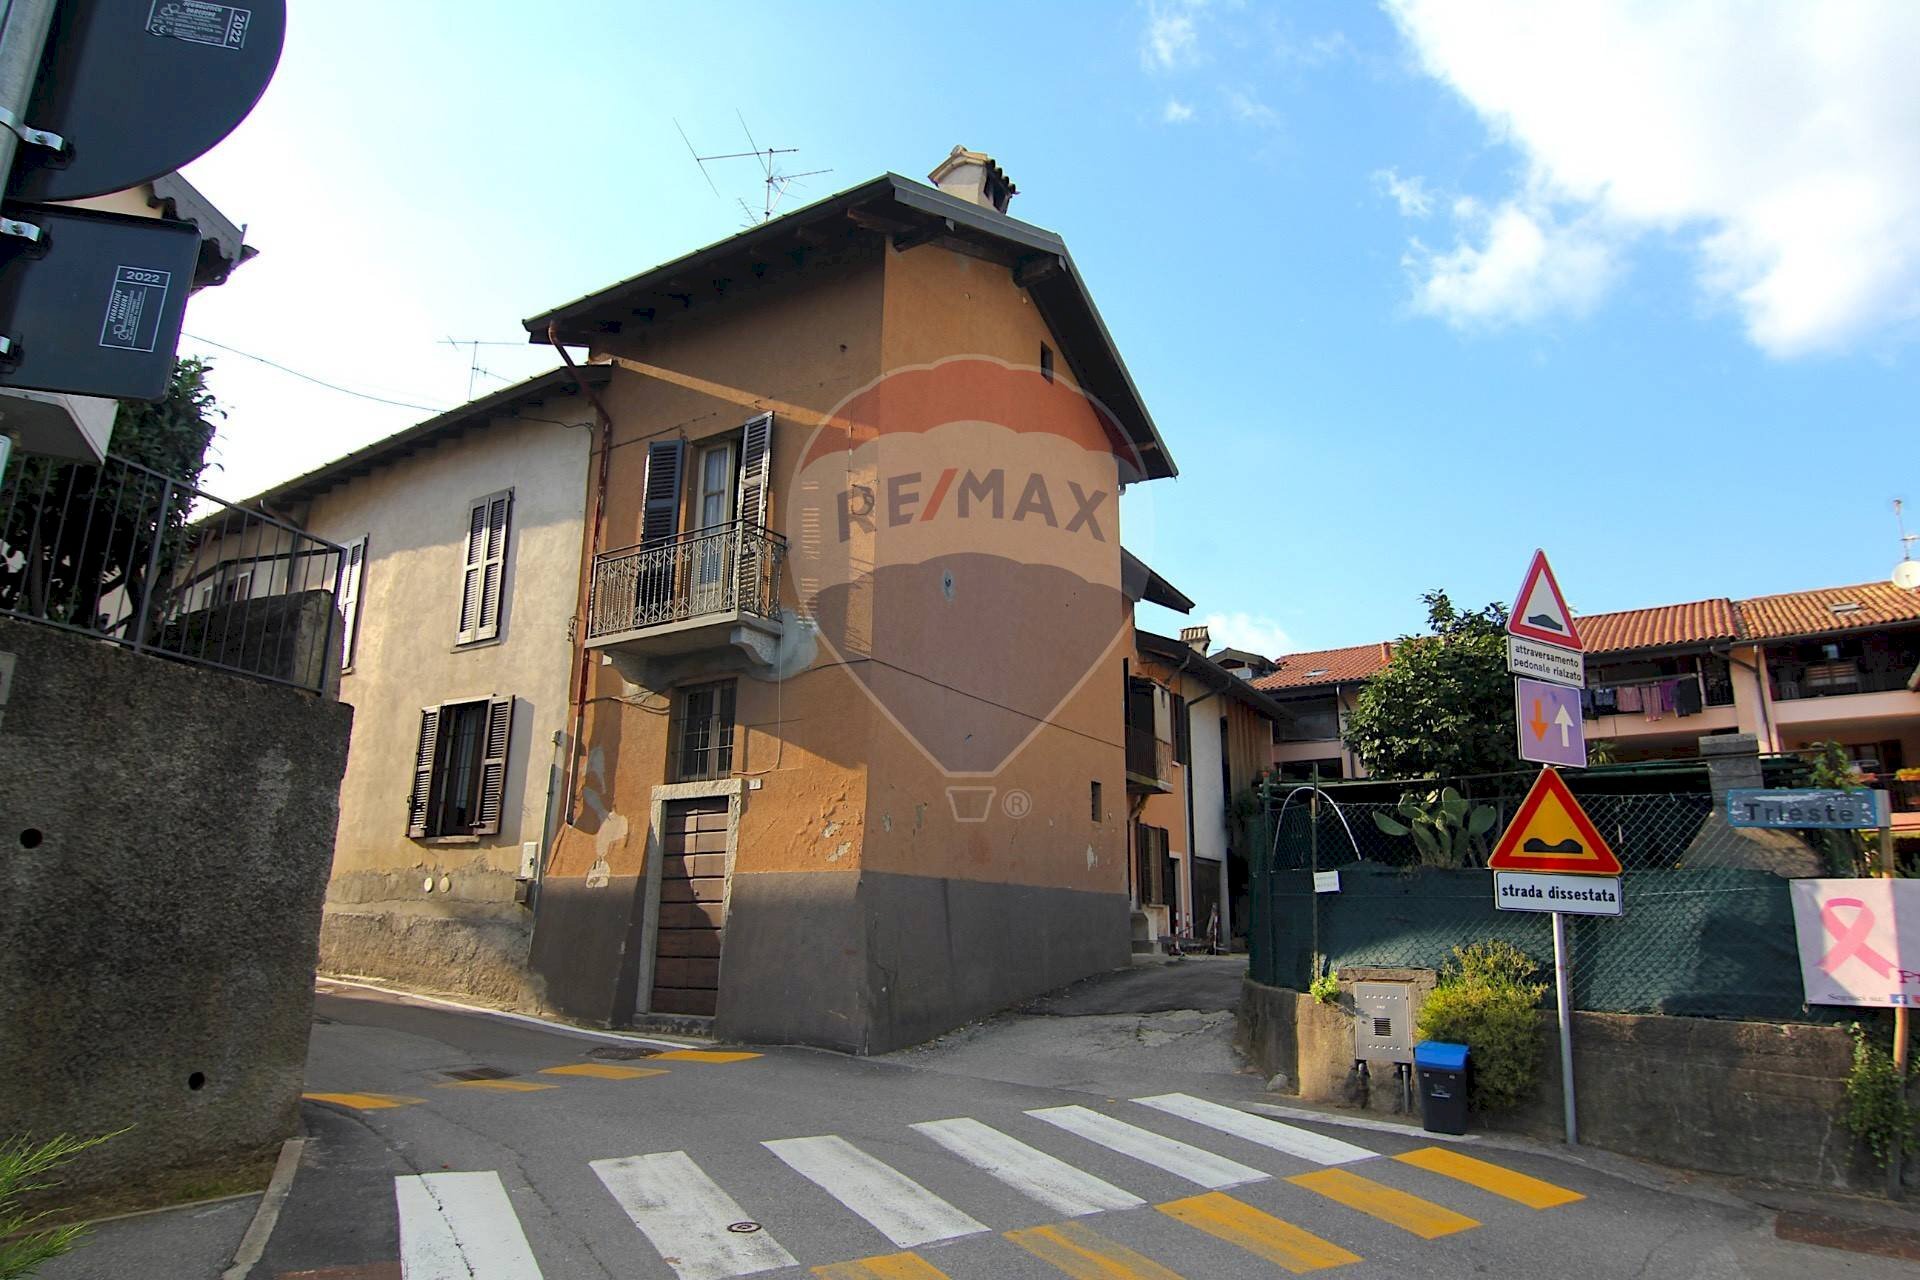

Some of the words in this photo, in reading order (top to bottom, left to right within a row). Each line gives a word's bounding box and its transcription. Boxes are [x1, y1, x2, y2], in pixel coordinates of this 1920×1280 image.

[229, 14, 245, 43] 2022
[126, 271, 160, 283] 2022
[1515, 645, 1579, 668] attraversamento
[1514, 658, 1551, 674] pedonale
[1553, 667, 1581, 681] rialzato
[1743, 803, 1854, 822] Trieste
[1502, 884, 1543, 898] strada
[1548, 886, 1616, 902] dissestata
